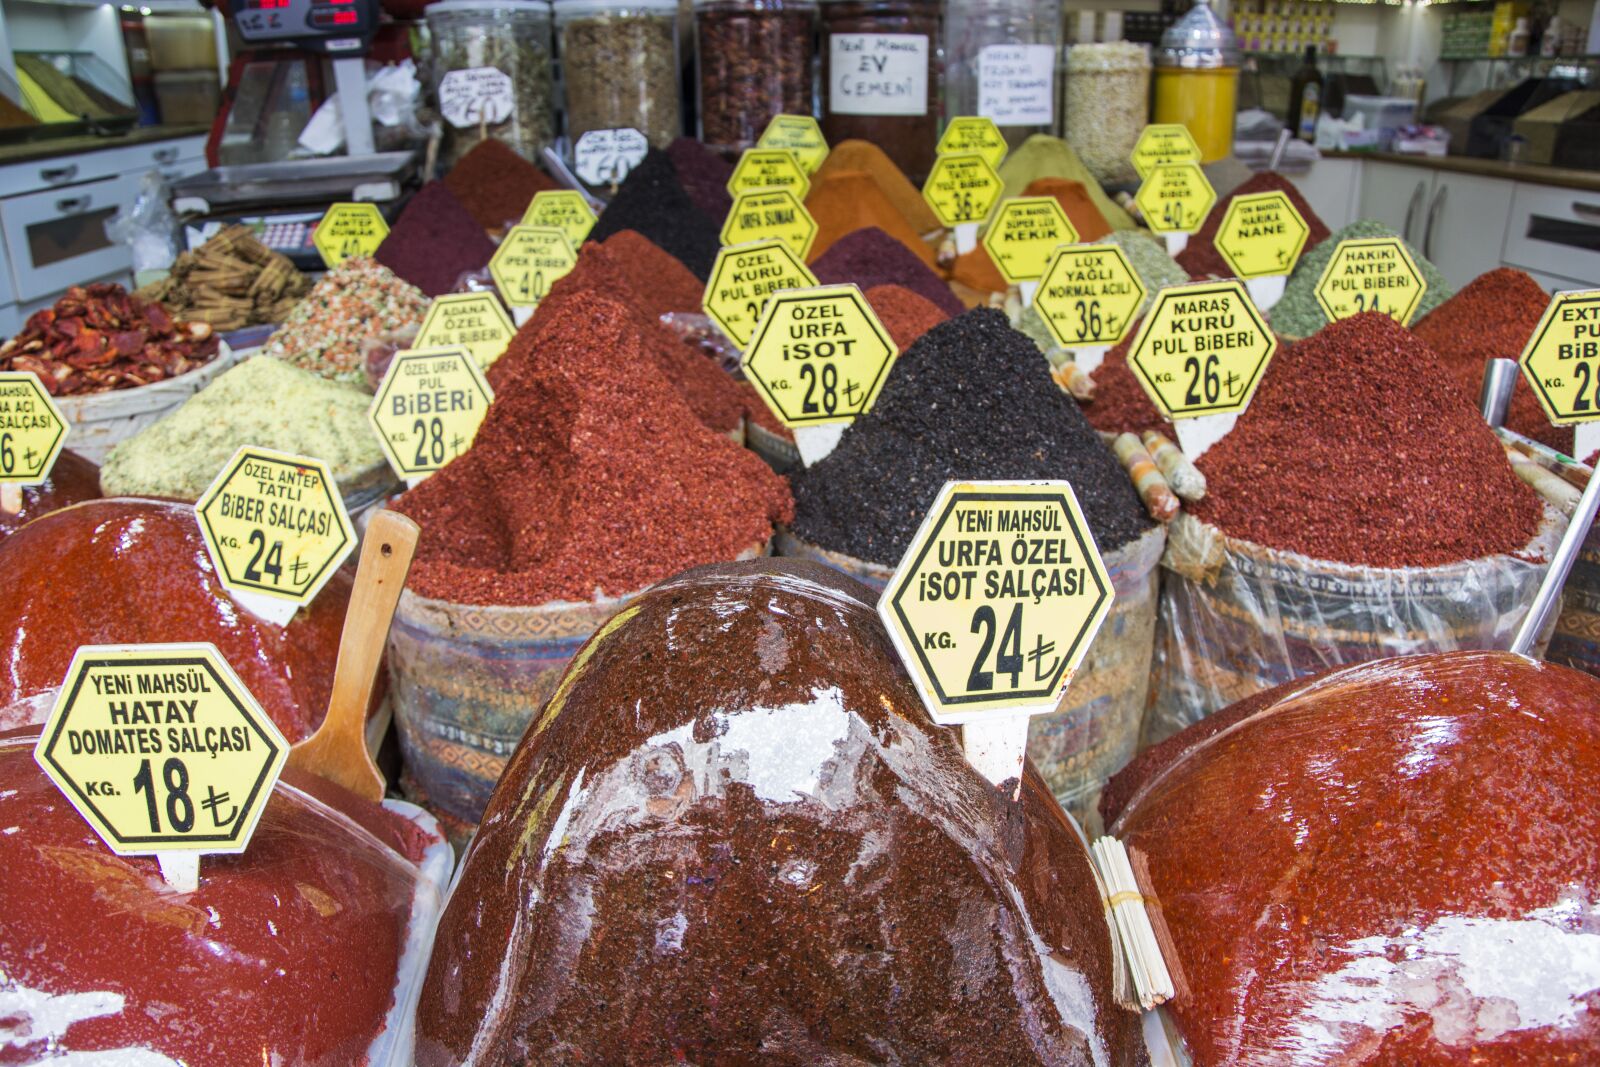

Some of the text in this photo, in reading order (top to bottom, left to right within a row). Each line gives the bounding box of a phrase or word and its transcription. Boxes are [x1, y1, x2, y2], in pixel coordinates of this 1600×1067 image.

[858, 55, 888, 73] EV
[1238, 222, 1286, 239] NANE
[733, 265, 784, 284] KURU
[1344, 263, 1396, 275] ANTEP
[1048, 283, 1096, 298] NORMAL
[1331, 278, 1358, 291] PUL
[721, 287, 749, 303] PUL
[443, 304, 488, 317] ADANA
[791, 303, 844, 320] ÖZEL
[1174, 298, 1230, 315] MARAŞ
[1075, 300, 1102, 340] 36
[1171, 315, 1236, 334] KURU
[790, 322, 848, 339] URFA
[1152, 338, 1188, 356] PUL
[433, 360, 459, 374] URFA
[419, 377, 446, 390] PUL
[800, 363, 838, 416] 28
[1184, 354, 1220, 406] 26
[1544, 378, 1565, 388] KG.
[0, 384, 32, 397] AHSÜL
[15, 401, 35, 413] ACI
[413, 417, 445, 466] 28
[1, 433, 15, 474] 6
[278, 471, 319, 489] ANTEP
[258, 481, 302, 502] TATLI
[268, 502, 332, 538] SALÇASI
[997, 505, 1062, 532] MAHSÜL
[220, 535, 241, 550] KG.
[243, 529, 284, 585] 24
[938, 533, 1073, 567] URFA ÖZEL
[984, 568, 1086, 605] SALÇASI
[924, 632, 957, 650] KG.
[966, 602, 1024, 692] 24
[136, 668, 212, 695] MAHSÜL
[109, 700, 199, 725] HATAY
[69, 726, 252, 760] DOMATES SALÇASI
[86, 781, 121, 796] KG.
[133, 756, 196, 833] 18
